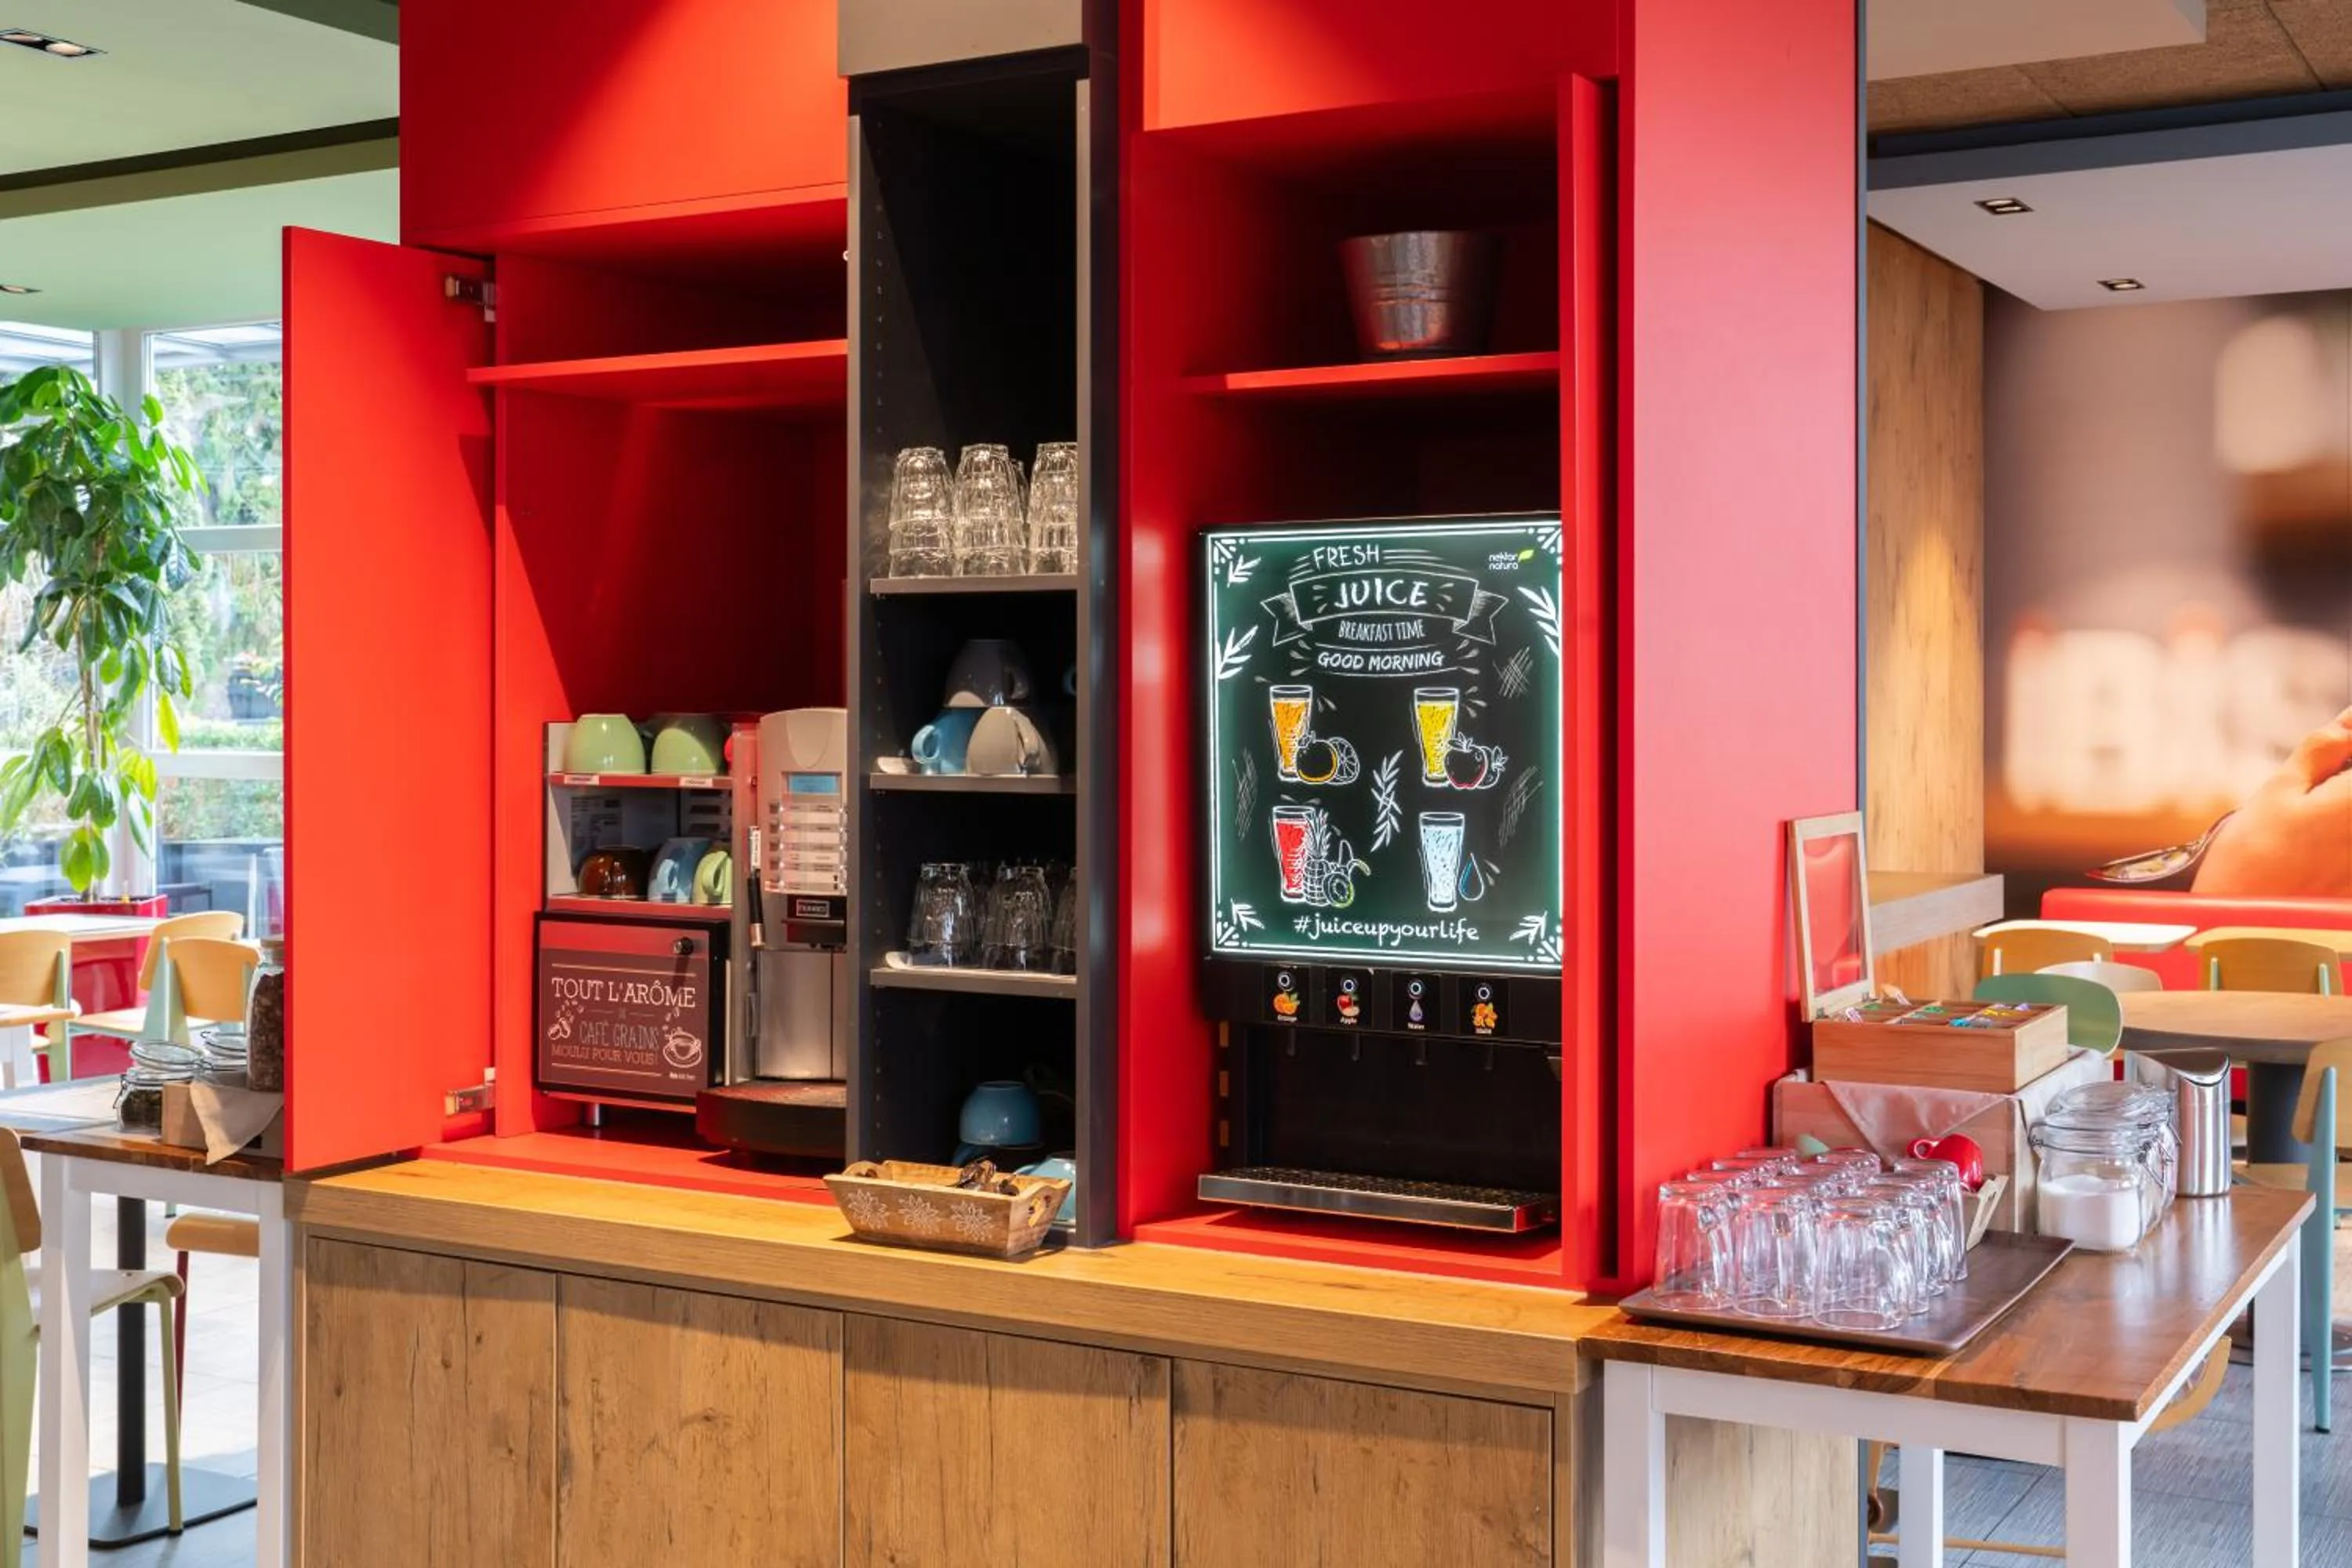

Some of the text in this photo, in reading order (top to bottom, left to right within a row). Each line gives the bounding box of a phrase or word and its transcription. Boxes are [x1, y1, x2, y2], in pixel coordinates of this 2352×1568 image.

[1312, 544, 1380, 569] FRESH
[1334, 578, 1429, 608] JUICE
[1338, 619, 1426, 642] BREAKFAST TIME
[1317, 650, 1446, 671] GOOD MORNING
[1293, 913, 1479, 946] #juiceupyourlife
[551, 978, 696, 1008] TOUT L'ARÔME
[614, 1023, 660, 1051] GRAINS
[592, 1046, 622, 1062] POUR
